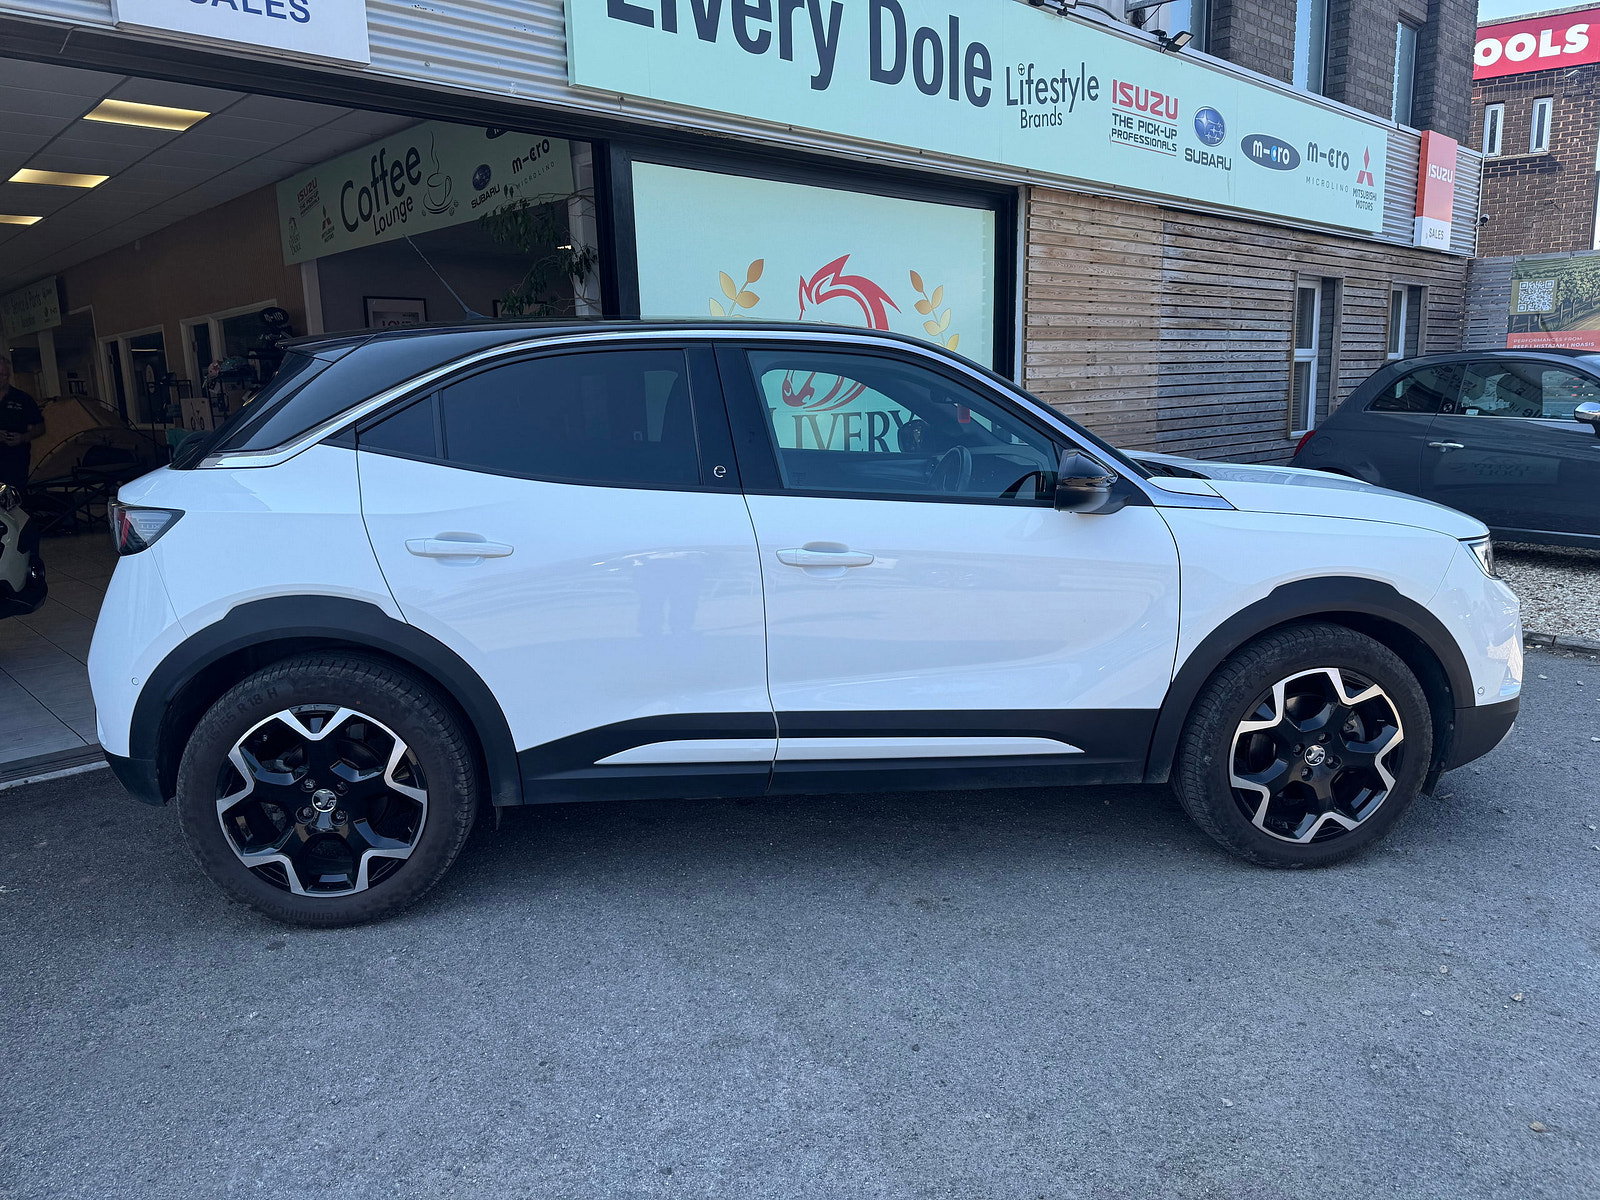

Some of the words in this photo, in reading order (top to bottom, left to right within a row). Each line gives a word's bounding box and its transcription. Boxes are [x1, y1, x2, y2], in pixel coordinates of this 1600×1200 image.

[869, 0, 992, 108] Dole
[1005, 62, 1100, 113] Lifestyle
[1112, 79, 1179, 121] ISUZU
[1020, 106, 1063, 129] Brands
[1112, 113, 1133, 130] THE
[1137, 119, 1178, 141] PICK-UP
[1111, 128, 1177, 153] PROFESSIONALS
[1184, 147, 1232, 171] SUBARU
[1305, 176, 1349, 193] MICROLINO
[1428, 163, 1454, 184] ISUZU
[341, 147, 422, 233] Coffee
[470, 184, 501, 209] SUBARU
[1352, 187, 1378, 202] MITSUBISHI
[373, 196, 414, 236] Lounge
[1355, 199, 1374, 212] MOTORS
[1428, 227, 1445, 241] SALES
